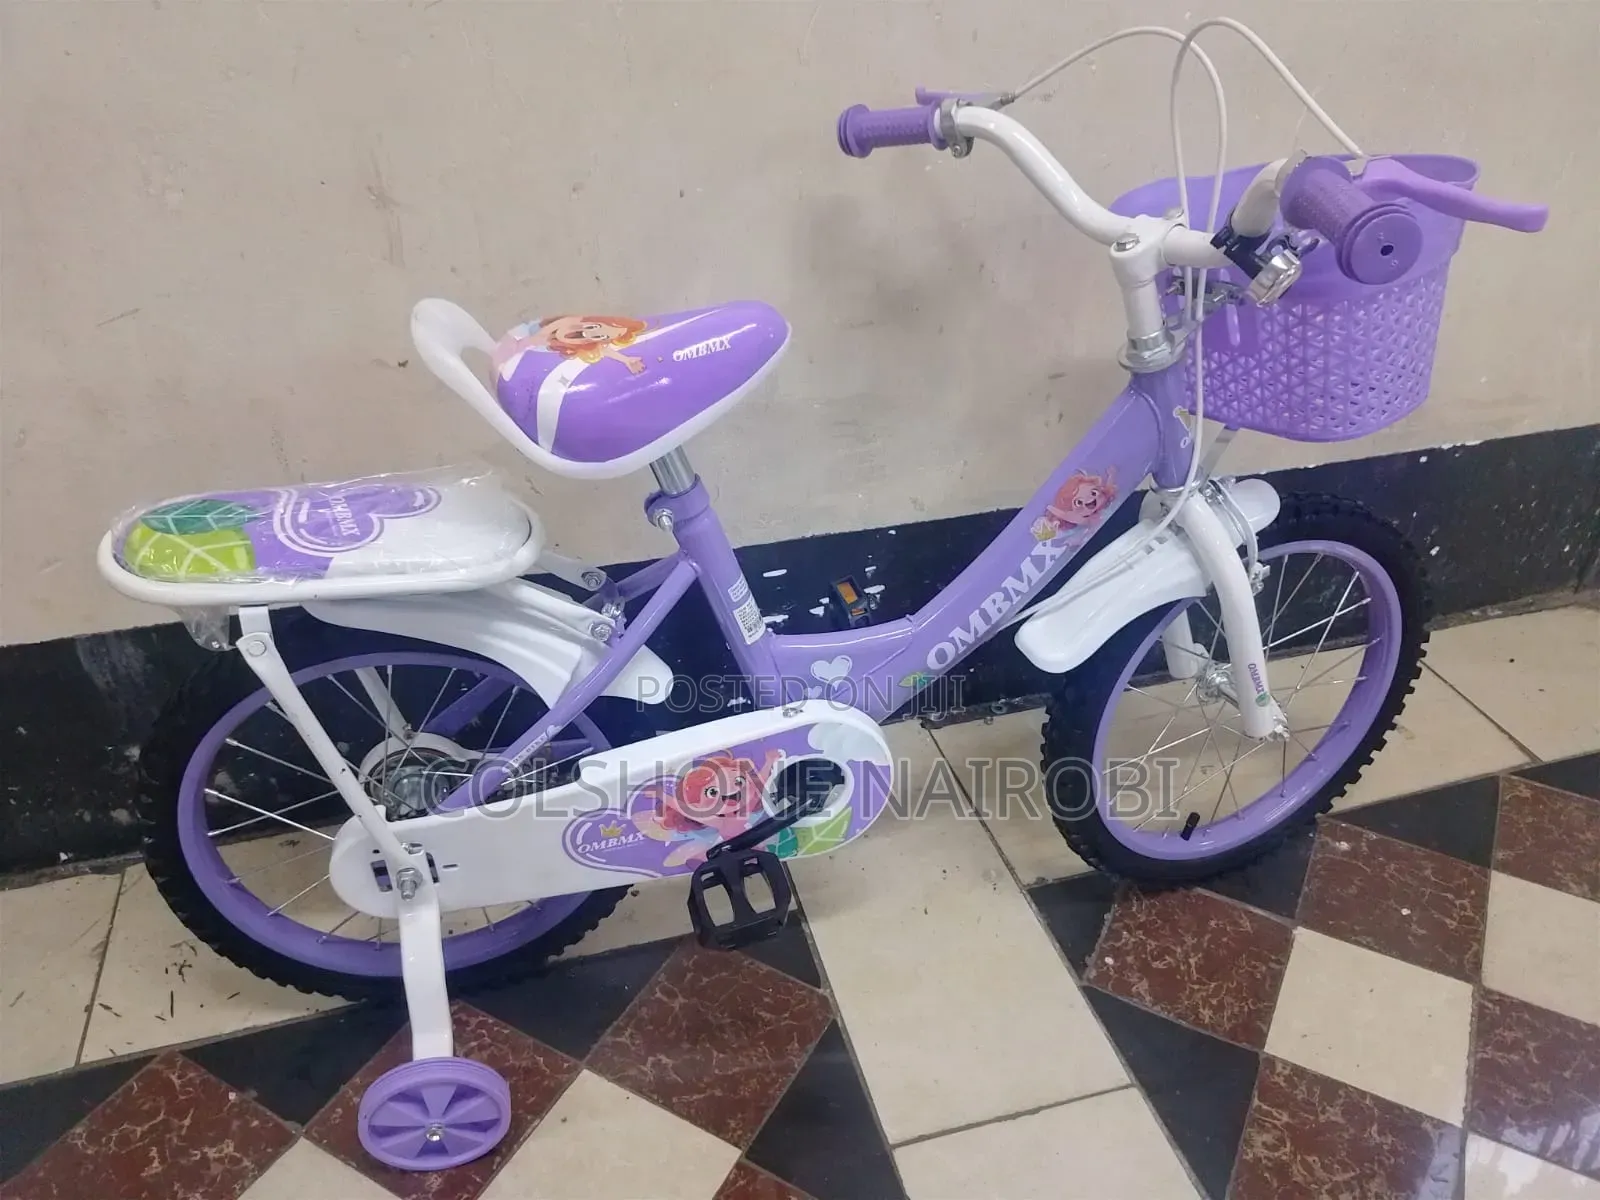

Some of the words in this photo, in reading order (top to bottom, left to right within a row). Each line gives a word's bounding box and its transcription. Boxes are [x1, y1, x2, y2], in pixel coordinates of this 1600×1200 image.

[672, 335, 732, 361] OMBMX
[329, 495, 361, 536] OMBMX
[926, 541, 1067, 670] OMBMX
[577, 832, 645, 854] OMBMX
